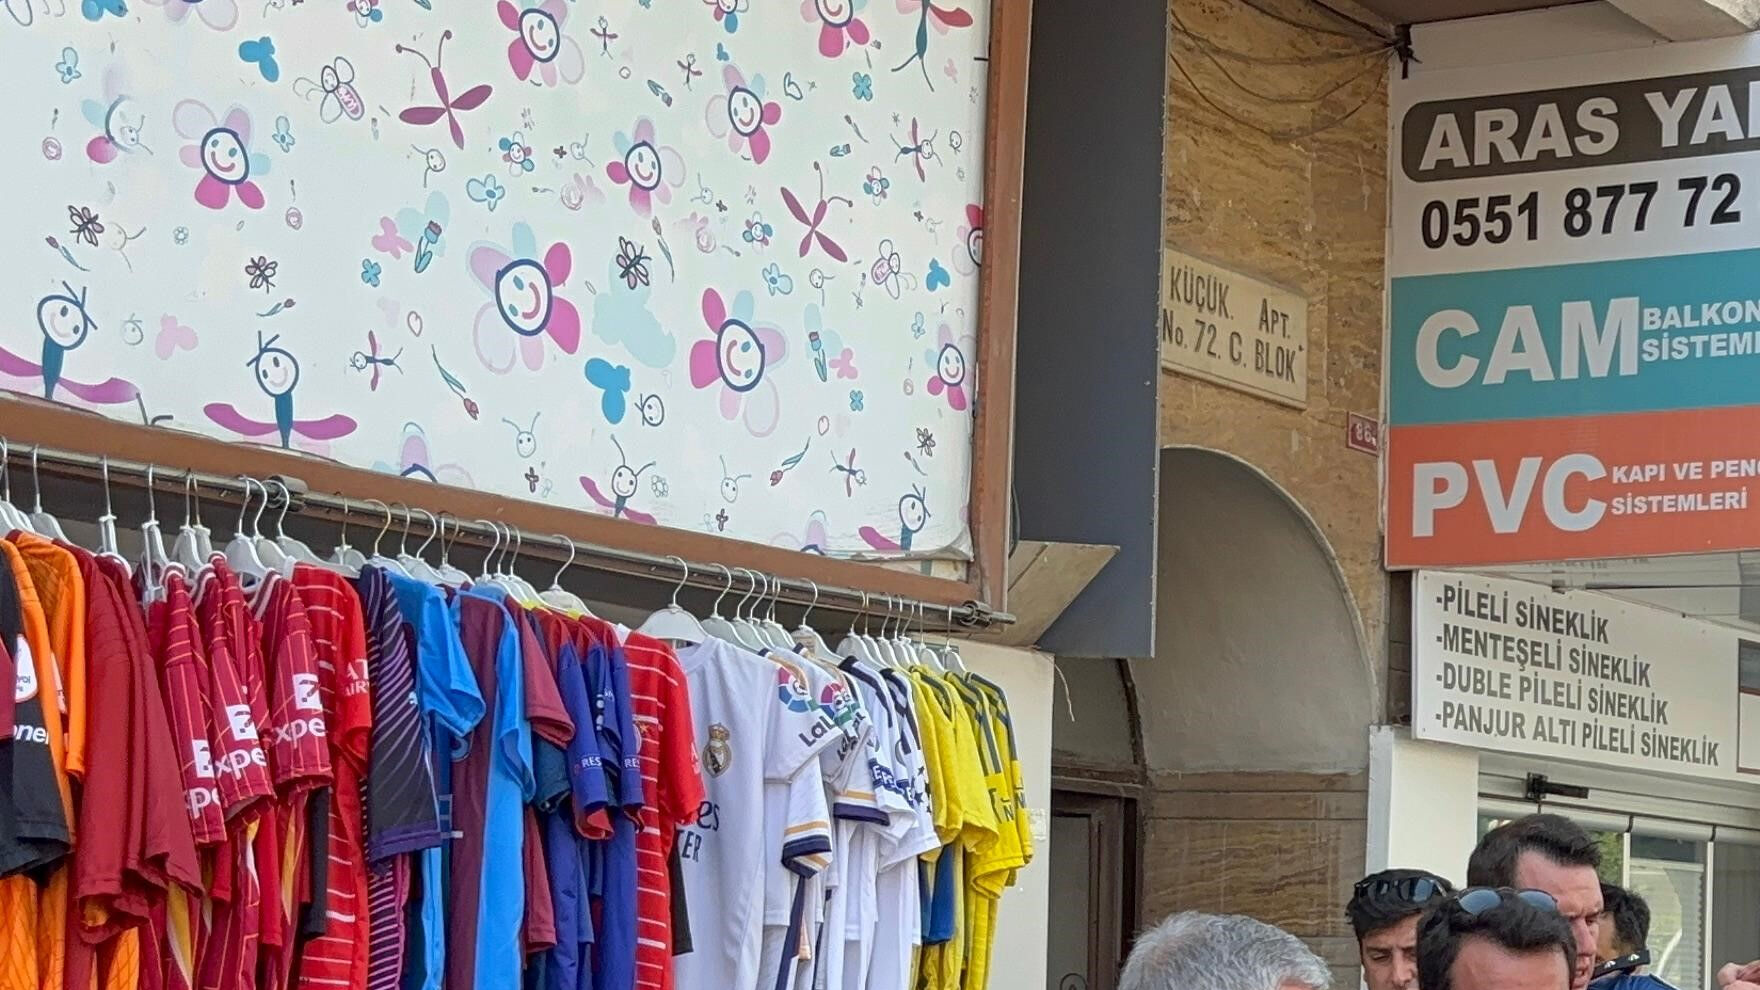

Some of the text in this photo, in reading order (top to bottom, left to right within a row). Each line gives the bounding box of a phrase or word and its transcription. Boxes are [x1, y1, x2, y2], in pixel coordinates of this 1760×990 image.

[1419, 98, 1620, 170] ARAS
[1421, 192, 1540, 249] 0551
[1564, 182, 1659, 238] 877
[1678, 175, 1742, 227] 72
[1194, 319, 1221, 359] 72.
[1229, 331, 1247, 368] C.
[1255, 339, 1296, 382] BLOK
[1416, 297, 1640, 389] CAM
[1412, 453, 1607, 537] PVC
[1612, 464, 1665, 483] KAPI
[1673, 462, 1703, 480] VE
[1611, 486, 1748, 515] SİSTEMLERİ
[1515, 596, 1609, 645] SİNEKLİK
[1568, 643, 1651, 689] SİNEKLİK
[1519, 671, 1582, 711] PİLELİ
[1588, 682, 1668, 726] SİNEKLİK
[798, 715, 836, 748] LaL
[1532, 715, 1576, 747] ALTI
[1582, 717, 1635, 756] PİLELİ
[1640, 728, 1719, 767] SİNEKLİK
[582, 756, 602, 768] RES
